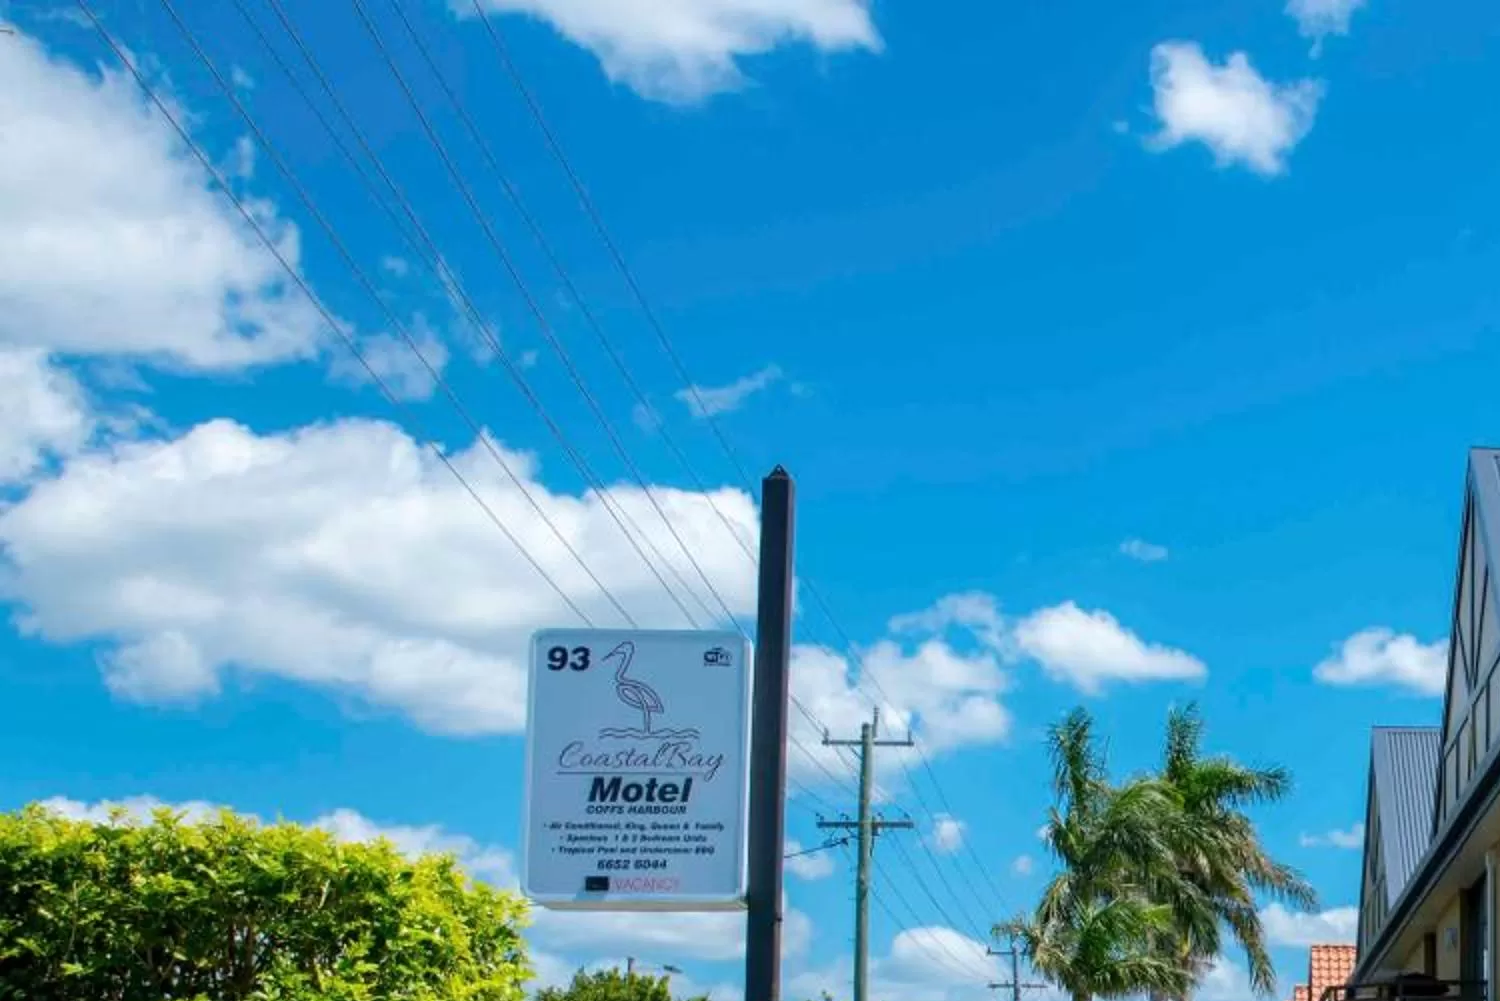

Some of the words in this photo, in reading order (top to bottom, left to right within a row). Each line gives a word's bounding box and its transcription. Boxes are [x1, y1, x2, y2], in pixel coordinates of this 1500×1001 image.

[547, 646, 590, 671] 93
[588, 776, 693, 802] Motel
[586, 804, 624, 815] COFFS
[627, 804, 687, 815] HARBOUR
